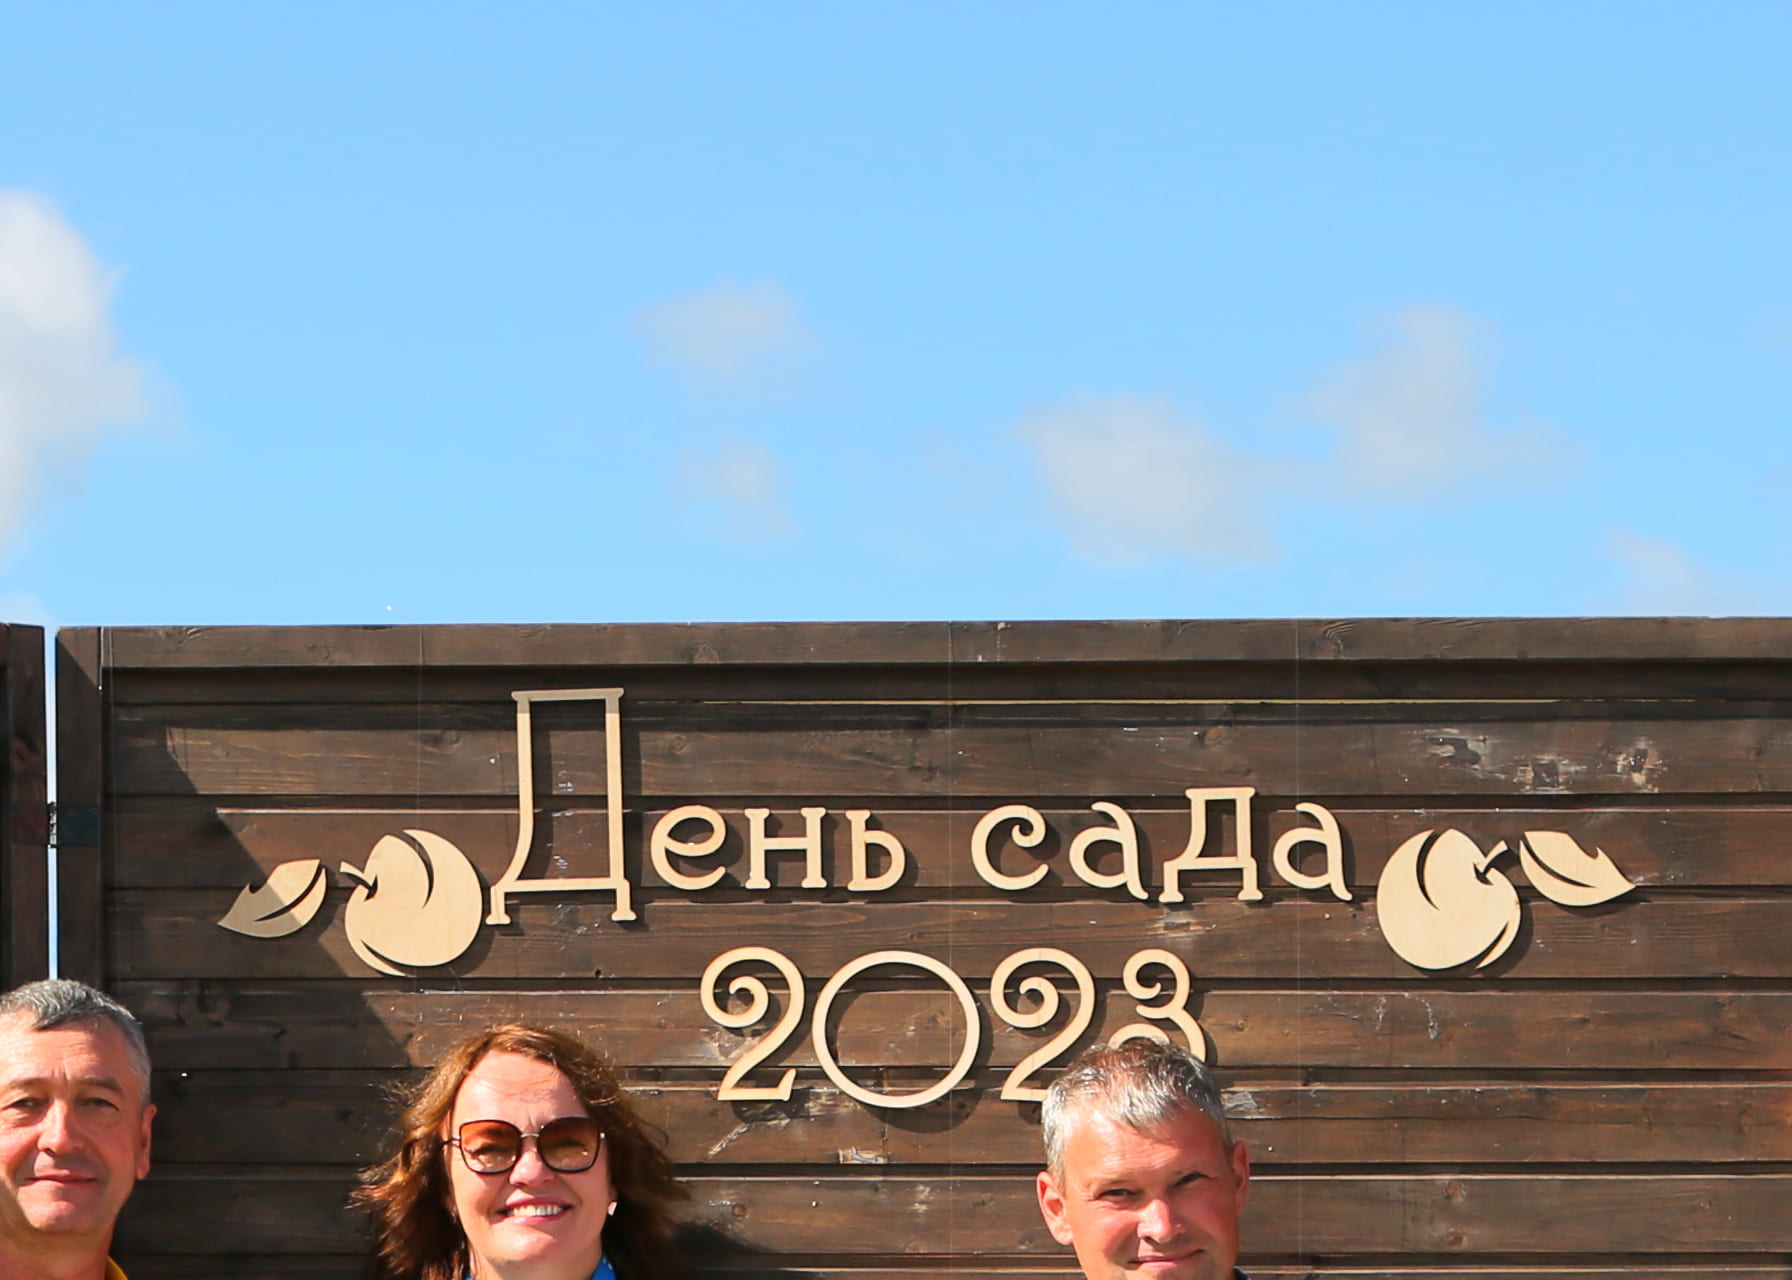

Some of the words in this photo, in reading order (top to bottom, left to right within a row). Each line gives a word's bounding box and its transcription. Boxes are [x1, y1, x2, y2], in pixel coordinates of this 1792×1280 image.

[486, 688, 907, 925] День
[971, 786, 1353, 904] сада
[701, 946, 1206, 1108] 2023
